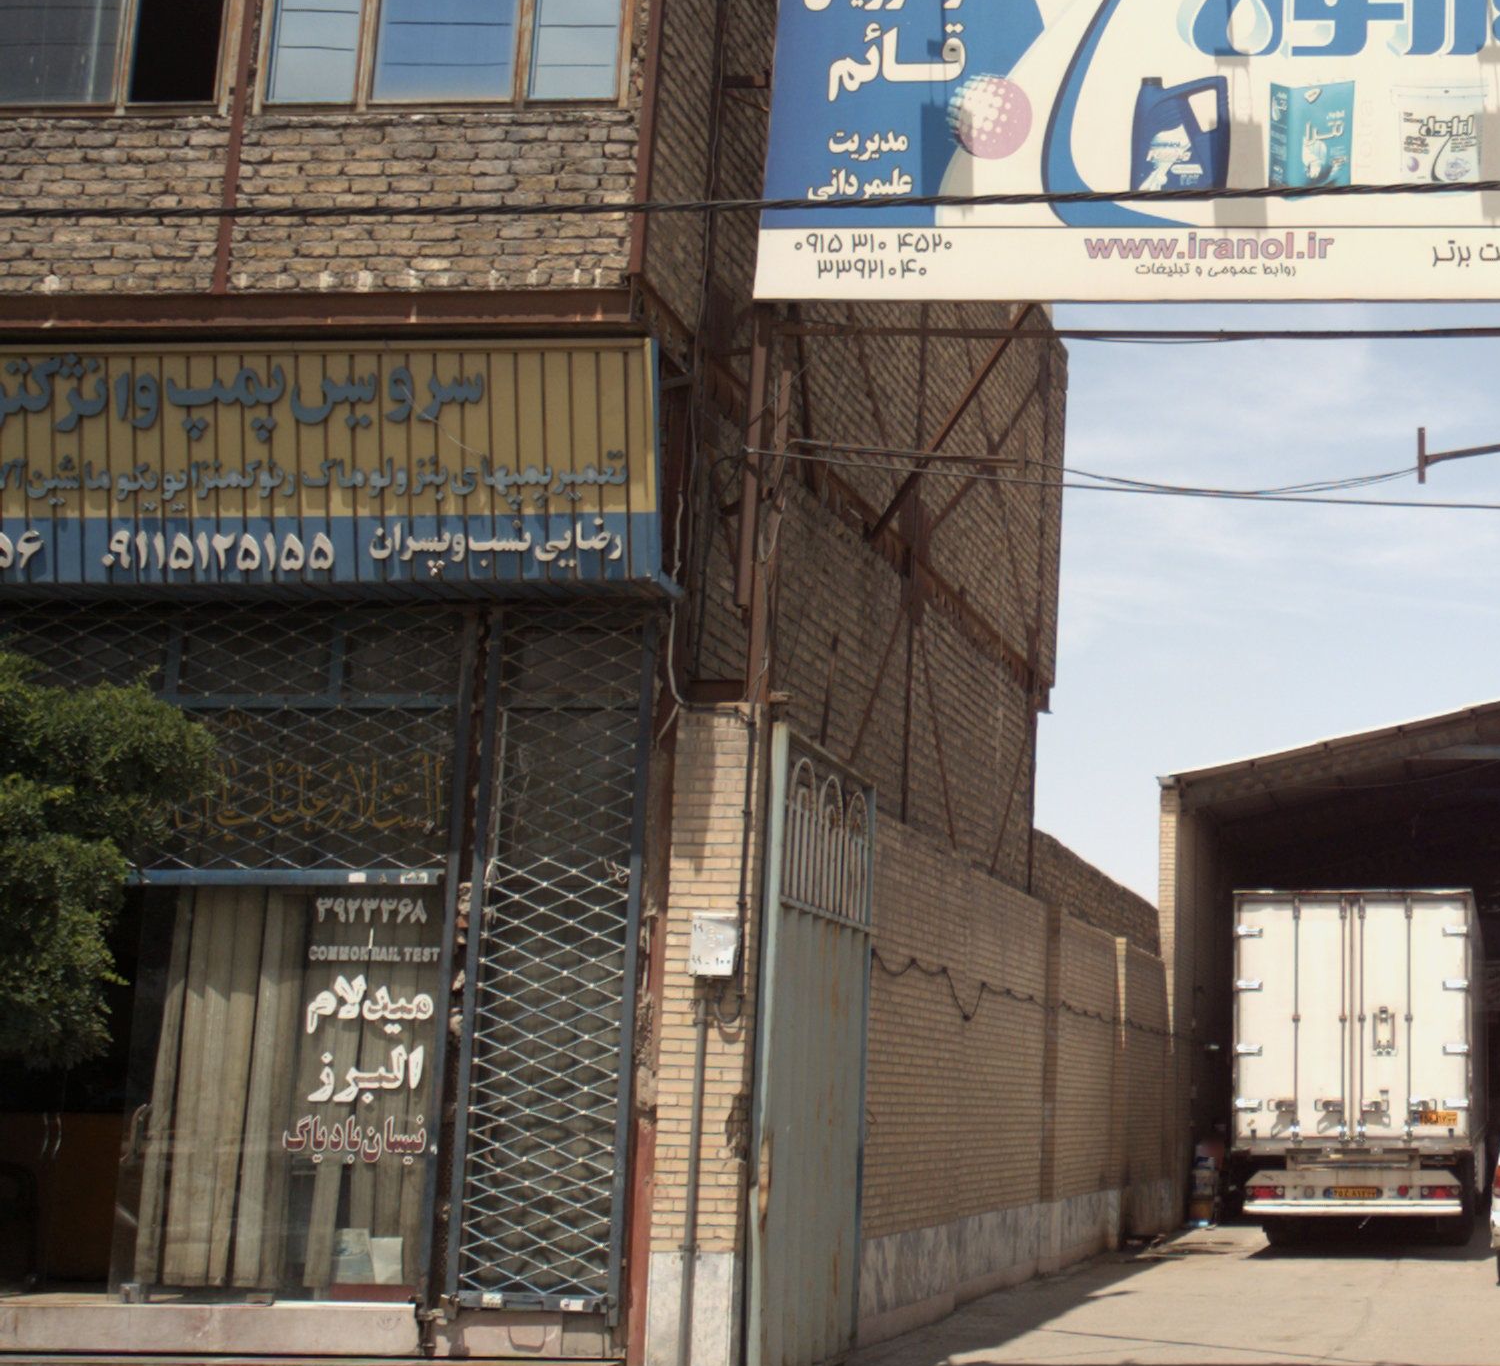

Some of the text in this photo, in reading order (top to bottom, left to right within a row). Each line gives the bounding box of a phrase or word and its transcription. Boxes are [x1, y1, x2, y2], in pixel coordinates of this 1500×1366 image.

[827, 22, 966, 102] قائم
[828, 131, 908, 161] مدیریت
[794, 233, 952, 253] ۰۹۱۵ ۳۱۰ ۴۵۲۰
[1084, 231, 1335, 260] www.iranol.ir
[1432, 240, 1471, 267] برتر
[817, 259, 927, 279] ۳۳۹۲۱۰۴۰
[1135, 263, 1296, 277] روابط عمومی و تبلیغات
[166, 363, 286, 442] پمپ
[291, 366, 484, 427] سرویس
[553, 449, 629, 501] تعمیر
[101, 529, 335, 571] ۰۹۱۱۵۱۲۵۱۵۵
[369, 522, 451, 578] پسران
[535, 516, 623, 568] رضایی
[404, 947, 440, 962] TEST
[306, 974, 435, 1035] میدلام
[306, 1044, 425, 1104] البرز
[361, 1114, 428, 1165] نیسان
